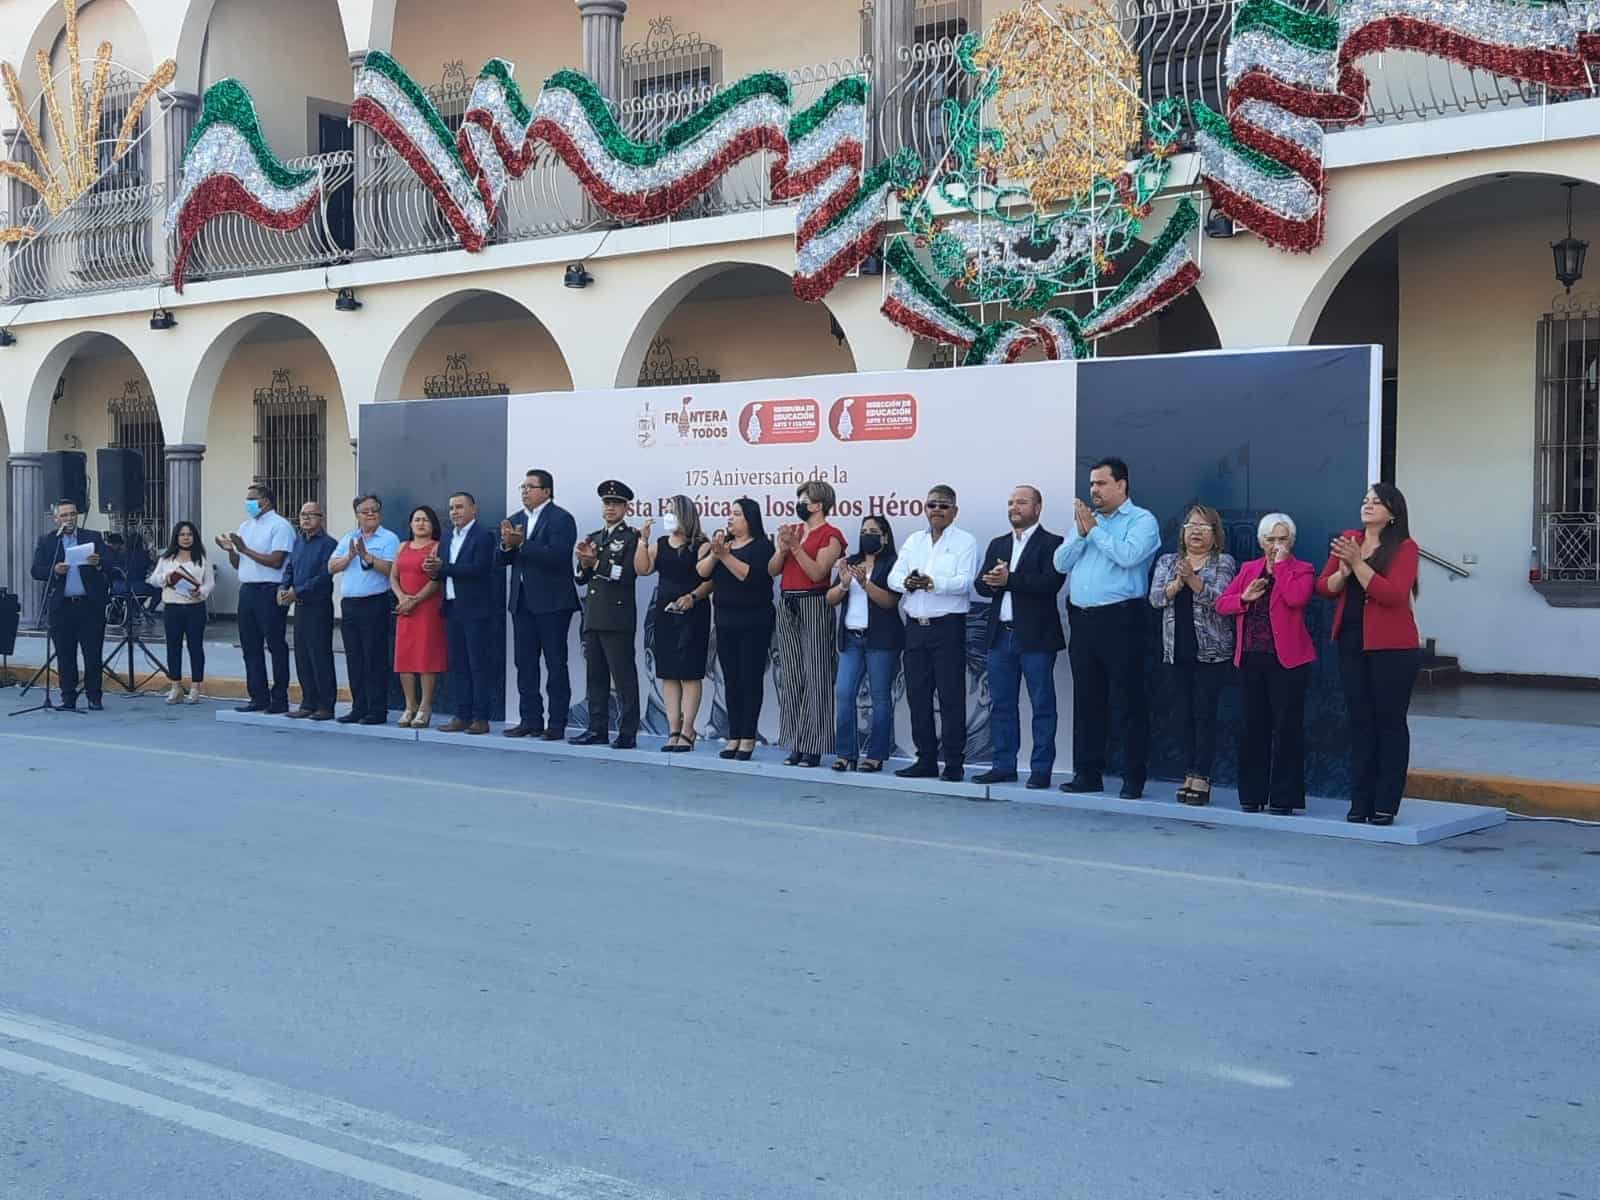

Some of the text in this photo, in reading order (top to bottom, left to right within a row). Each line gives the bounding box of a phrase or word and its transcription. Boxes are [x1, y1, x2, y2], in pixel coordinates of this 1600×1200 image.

[691, 427, 728, 439] TODOS
[686, 464, 848, 486] 175 Aniversario de la
[765, 494, 795, 517] los
[869, 492, 928, 517] Héro
